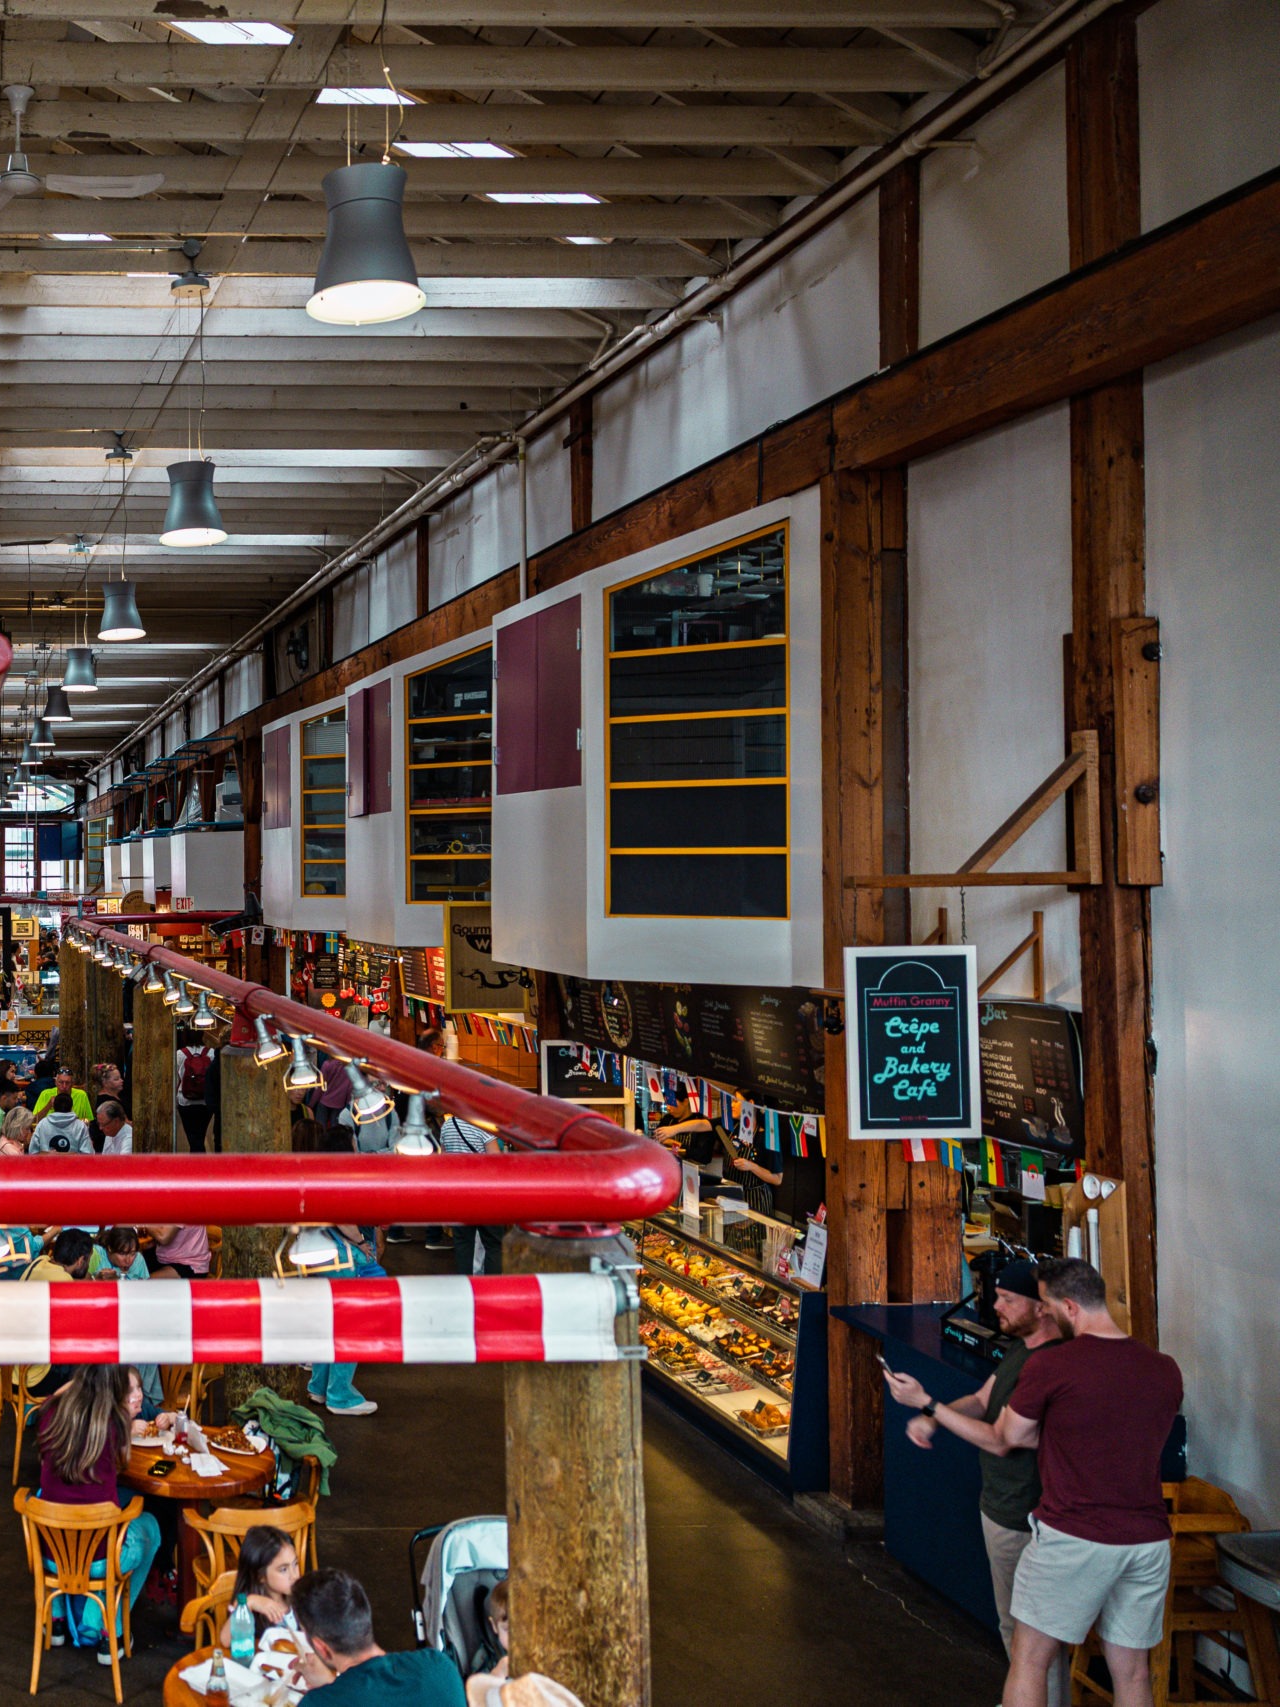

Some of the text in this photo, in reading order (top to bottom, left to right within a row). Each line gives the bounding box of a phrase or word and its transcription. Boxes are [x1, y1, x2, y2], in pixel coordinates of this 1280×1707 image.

[176, 897, 191, 910] EXIT
[452, 924, 491, 937] Gourm
[872, 996, 951, 1008] Muffin Granny
[981, 1003, 1008, 1025] Bar
[884, 1016, 940, 1041] Crêpe
[900, 1041, 926, 1054] and
[872, 1056, 951, 1084] Bakery
[893, 1078, 937, 1101] Café
